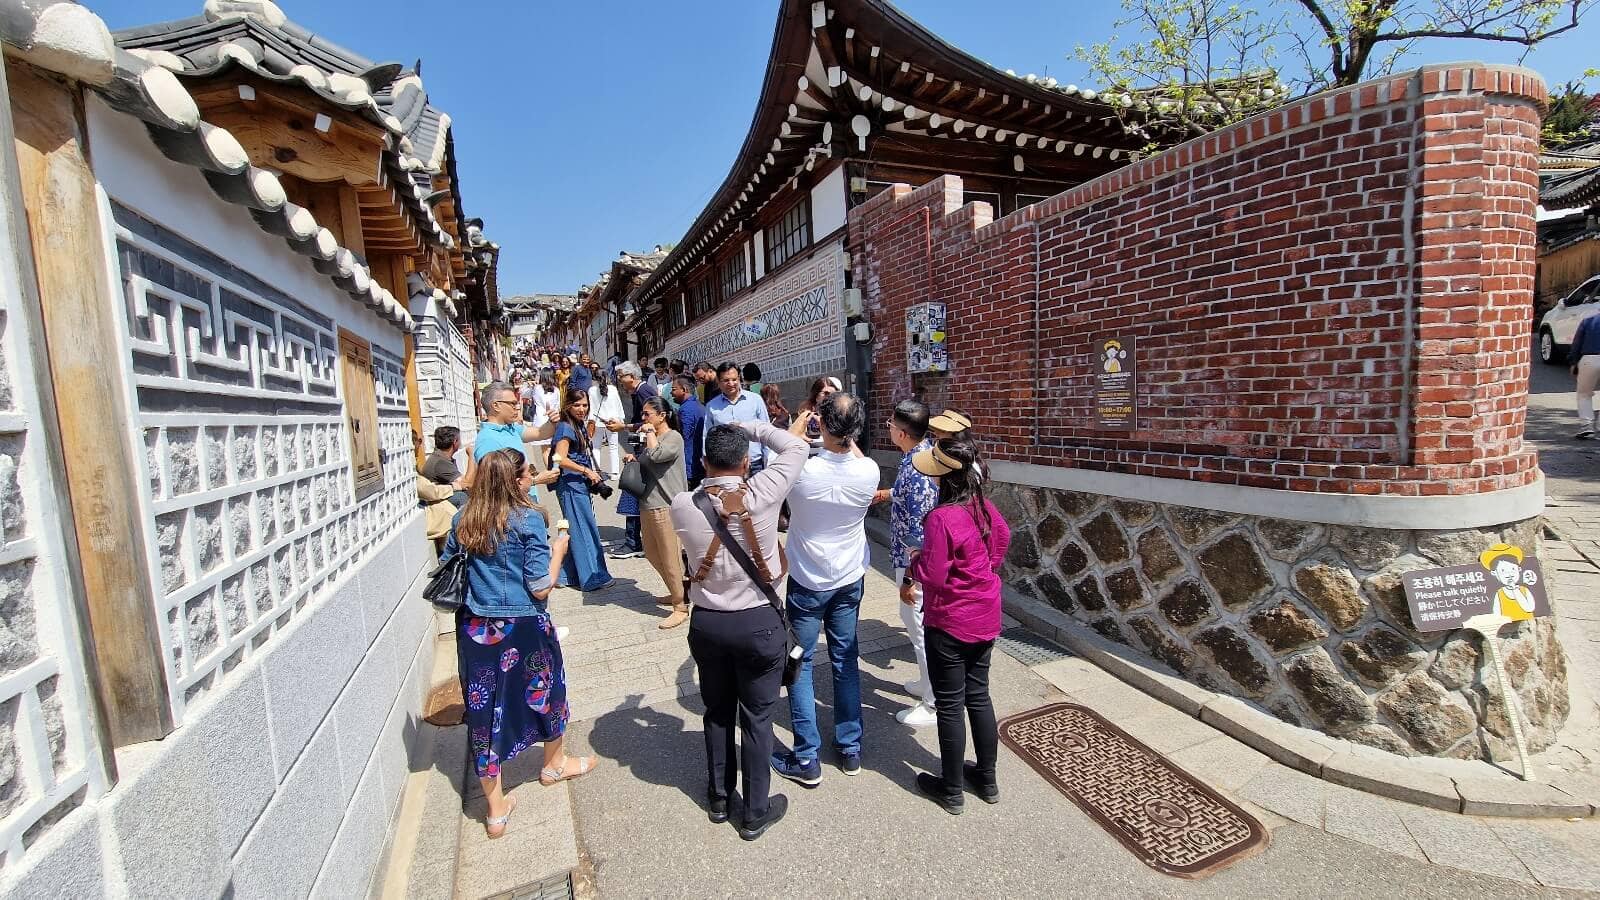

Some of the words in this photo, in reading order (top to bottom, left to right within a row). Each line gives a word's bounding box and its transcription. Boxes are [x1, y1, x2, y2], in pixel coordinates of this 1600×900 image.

[1413, 576, 1444, 589] 조용히
[1445, 571, 1485, 586] 해주세요
[1415, 590, 1442, 600] Please
[1442, 588, 1459, 597] talk
[1460, 585, 1487, 595] quietly
[1056, 733, 1086, 749] KT
[1149, 801, 1186, 823] KT
